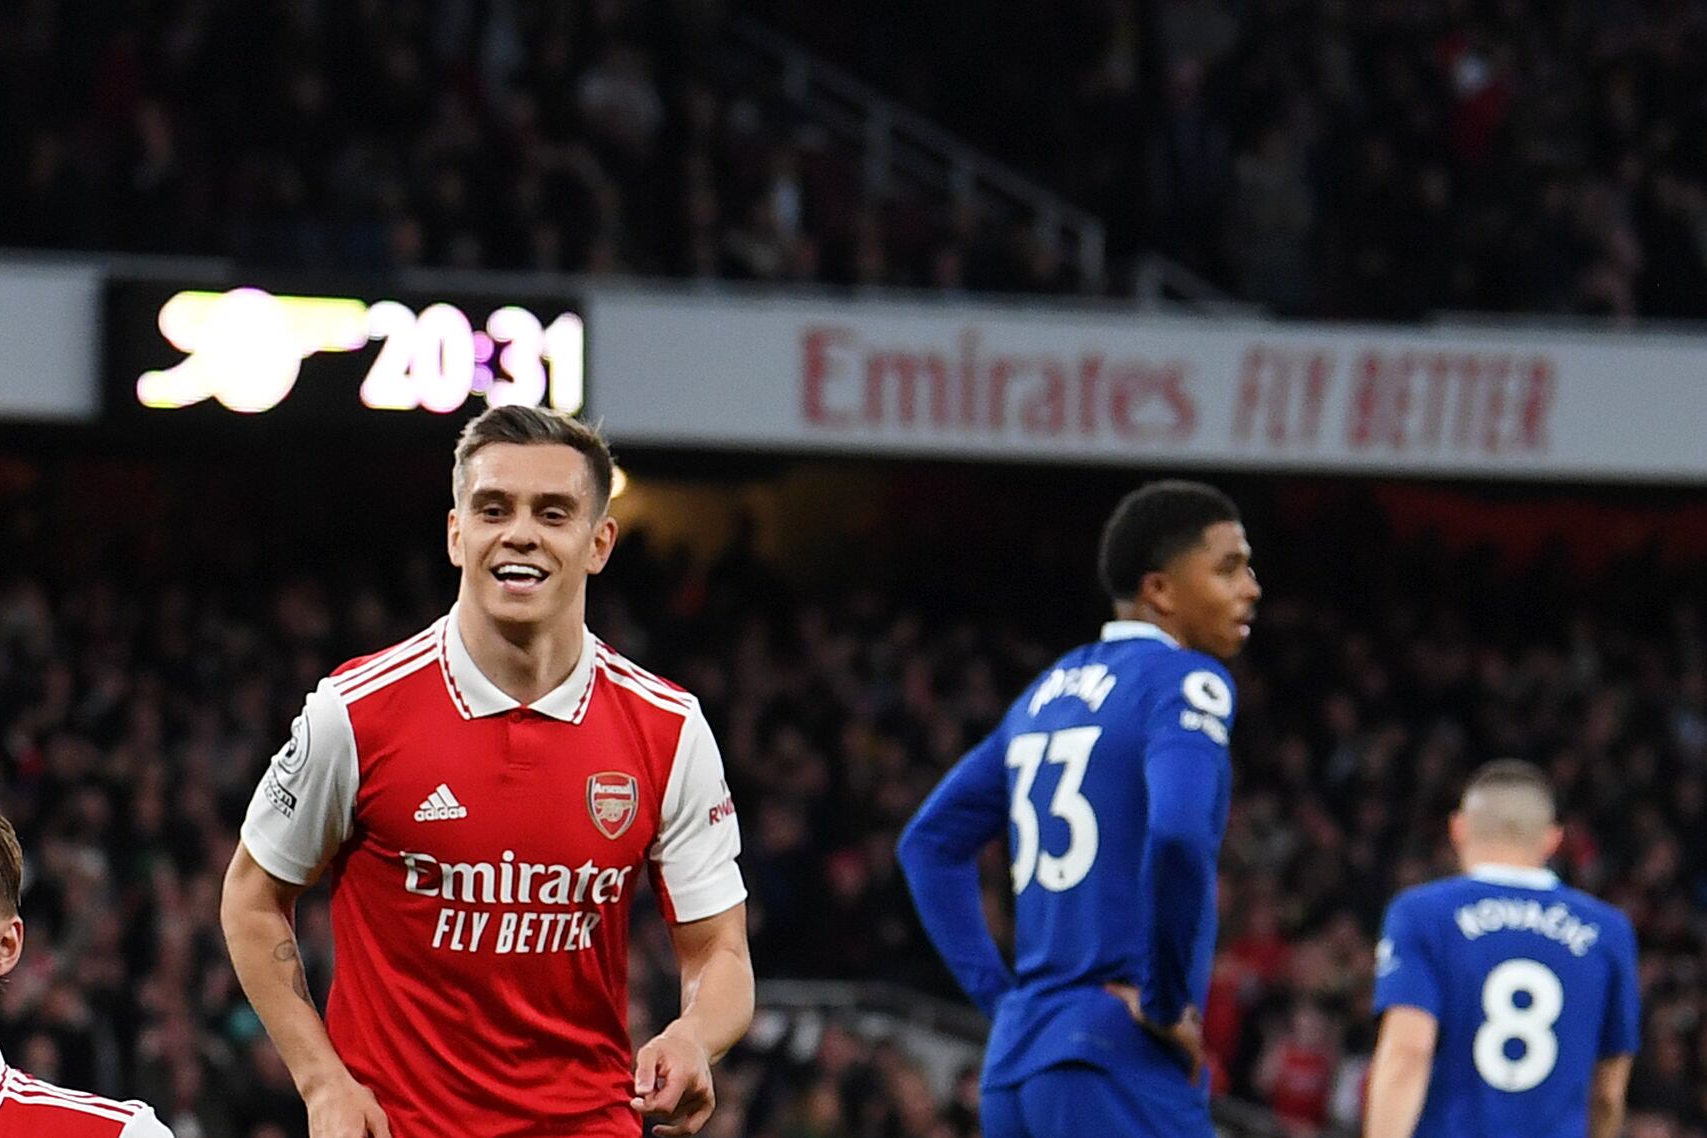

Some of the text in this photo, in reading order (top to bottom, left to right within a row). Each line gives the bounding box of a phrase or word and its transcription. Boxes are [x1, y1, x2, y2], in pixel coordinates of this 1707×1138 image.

[360, 302, 584, 415] 20:31
[798, 323, 1560, 453] Emirates FLY BETTER
[413, 805, 468, 822] adidas
[1004, 725, 1103, 896] 33
[431, 908, 602, 954] FLY BETTER
[1473, 957, 1564, 1093] 8
